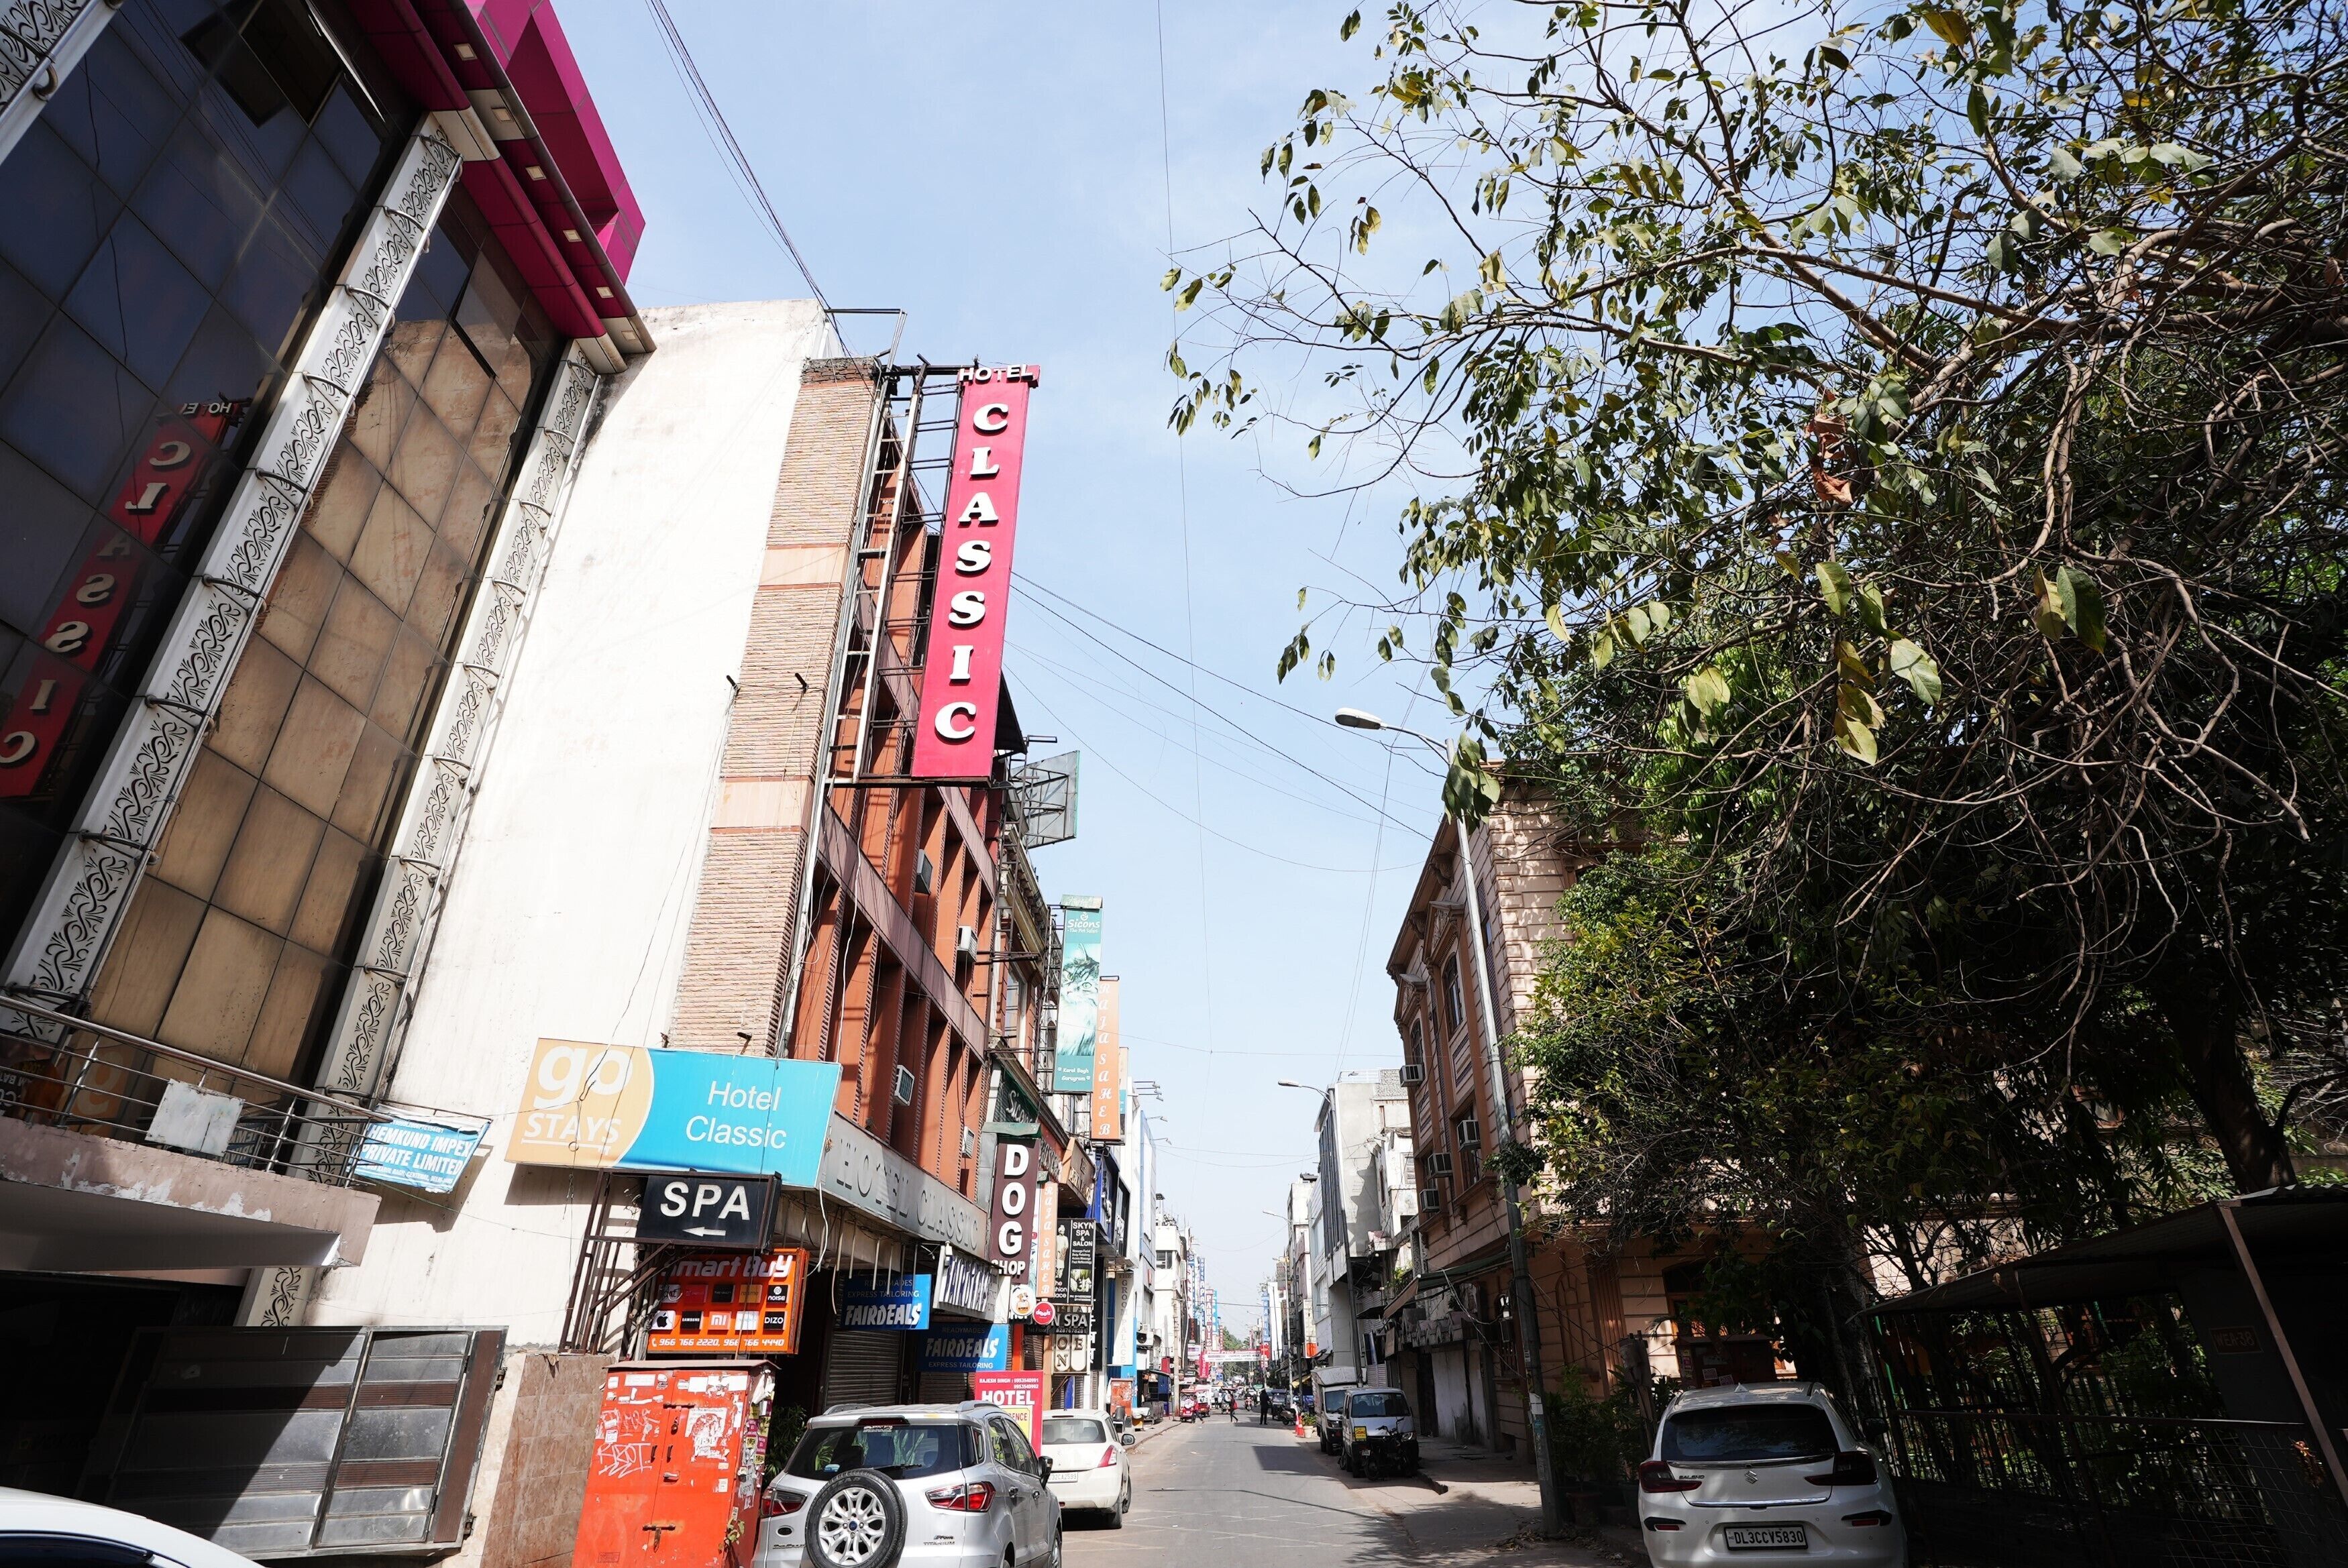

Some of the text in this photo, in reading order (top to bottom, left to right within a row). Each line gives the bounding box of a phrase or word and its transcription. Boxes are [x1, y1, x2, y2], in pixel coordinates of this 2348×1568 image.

[959, 364, 1034, 384] HOTEL
[935, 403, 1009, 740] CLASSIC
[1067, 919, 1100, 928] Sicons
[533, 1044, 633, 1109] go
[707, 1080, 781, 1111] Hotel
[525, 1112, 621, 1143] STAYS
[686, 1115, 787, 1149] Classic
[368, 1125, 431, 1149] HEMKUND
[431, 1136, 473, 1158] IMPEX
[361, 1143, 413, 1167] PRIVATE
[660, 1181, 750, 1221] SPA
[836, 1138, 979, 1251] HOTEL CLASSIC
[998, 1144, 1030, 1257] DOG
[743, 1254, 793, 1278] Buy
[992, 1259, 1026, 1276] SHOP
[847, 1290, 921, 1298] EXPRESS TAILORING
[845, 1302, 922, 1326] FAIRDEALS
[1064, 1314, 1088, 1327] SPA
[658, 1338, 676, 1347] 966
[761, 1338, 784, 1347] 4440
[942, 1327, 985, 1335] READYMADES
[925, 1338, 1000, 1359] FAIRDEALS
[981, 1390, 1035, 1406] HOTEL
[1734, 1530, 1804, 1545] DL3CCV5830
